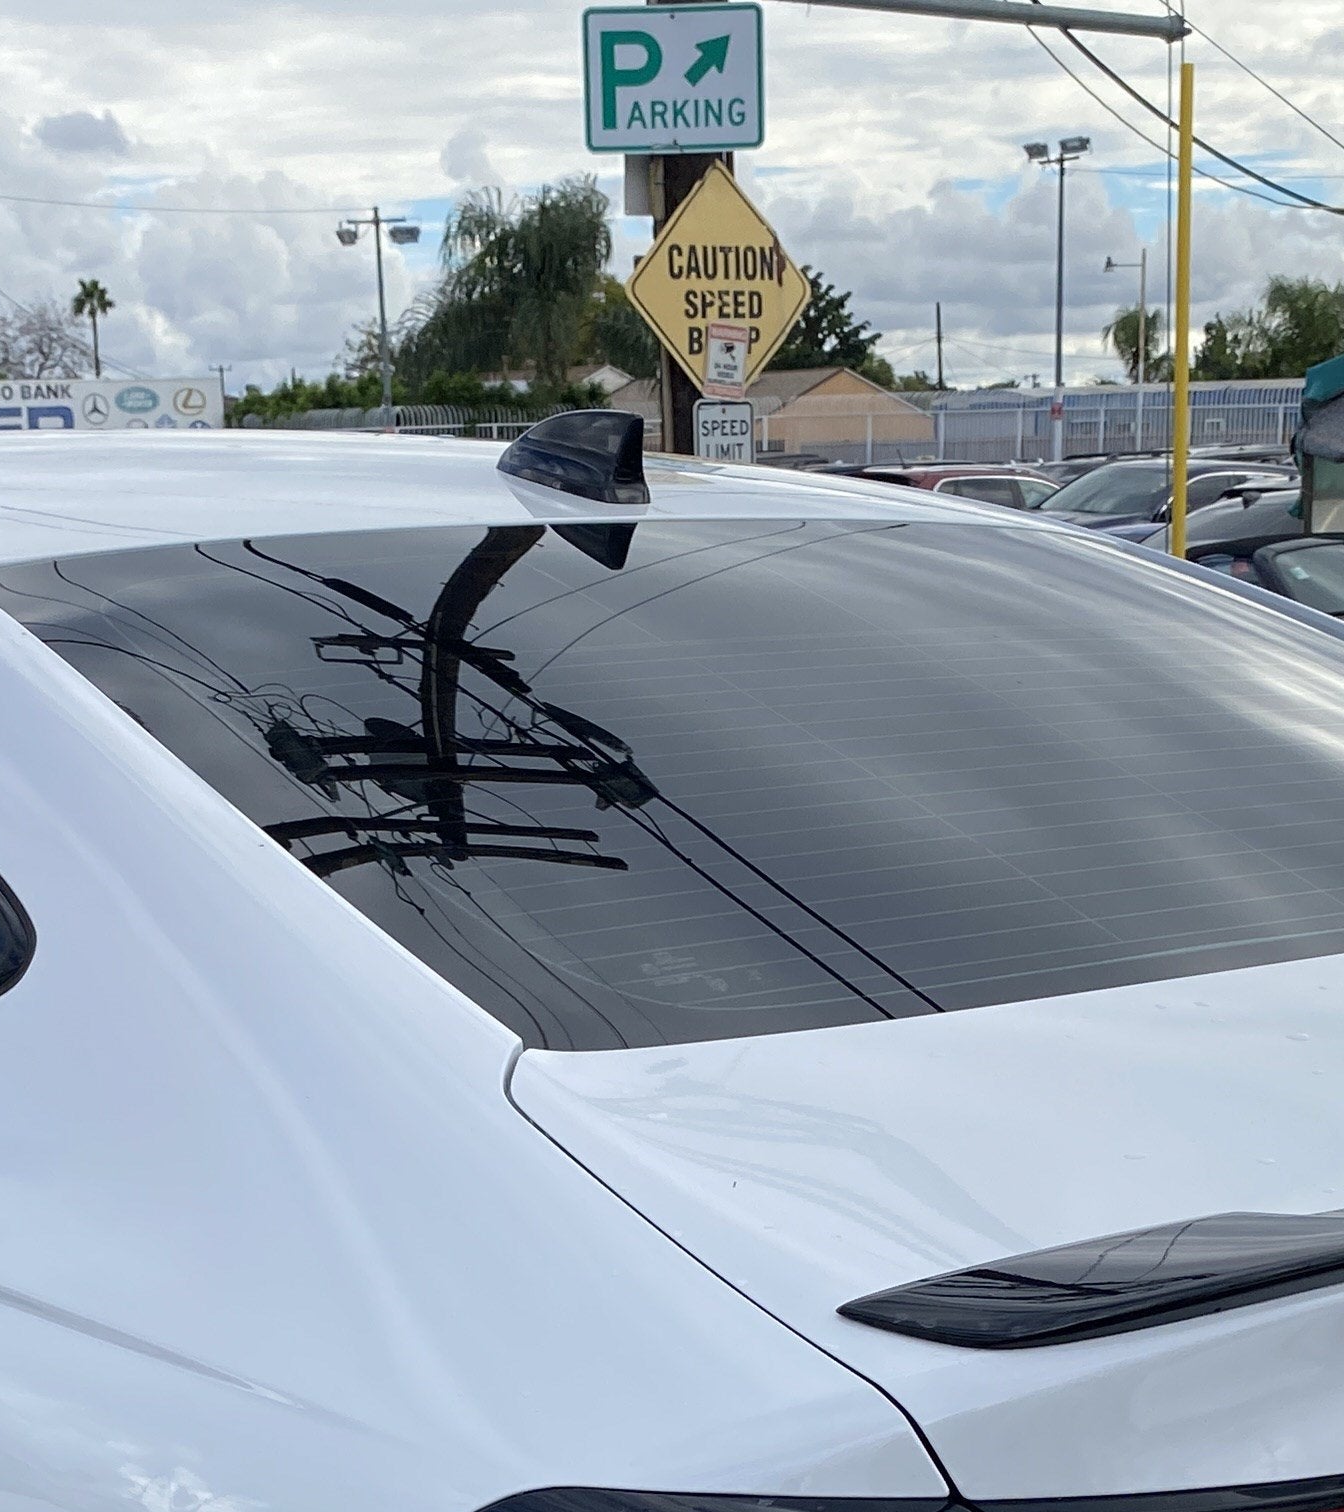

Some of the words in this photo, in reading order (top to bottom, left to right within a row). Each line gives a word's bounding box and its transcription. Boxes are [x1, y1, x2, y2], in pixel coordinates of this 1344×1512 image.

[601, 31, 746, 130] PARKING
[668, 244, 774, 281] CAUTION
[684, 289, 763, 319] SPEED
[688, 326, 760, 355] BP
[21, 384, 73, 400] BANK
[701, 420, 749, 437] SPEED
[706, 443, 744, 461] LIMIT
